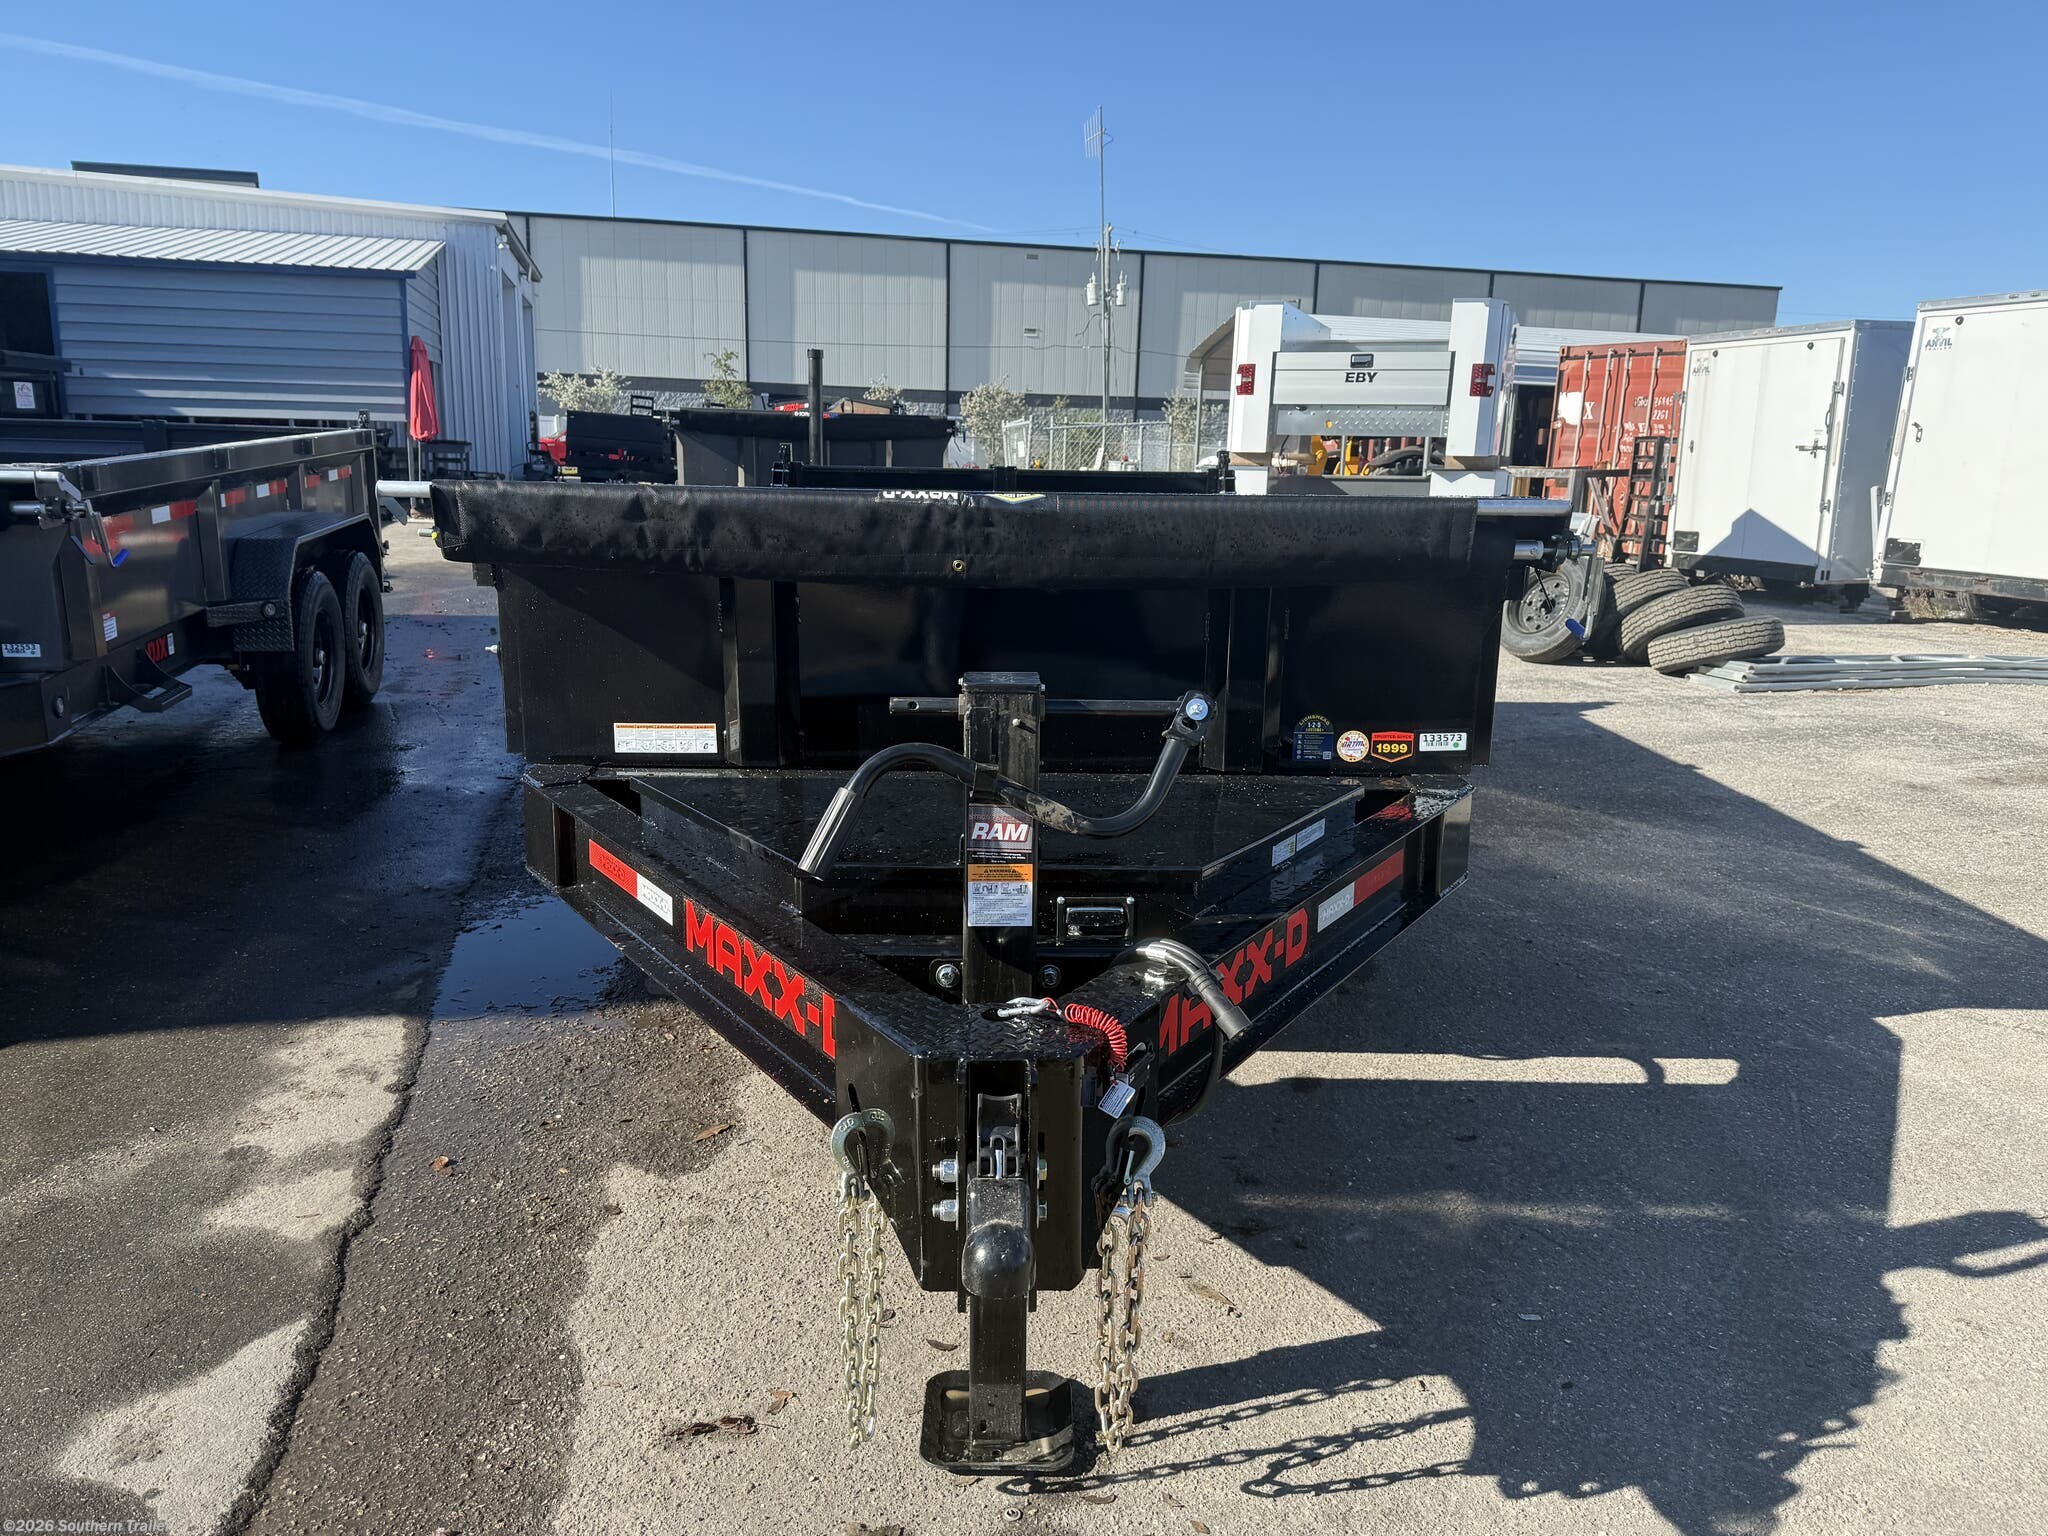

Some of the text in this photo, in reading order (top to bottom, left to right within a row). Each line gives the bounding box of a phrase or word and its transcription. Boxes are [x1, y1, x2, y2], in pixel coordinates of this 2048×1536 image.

[1345, 372, 1378, 383] EBY
[1423, 734, 1463, 742] 133573
[1376, 743, 1408, 753] 1999
[971, 822, 1029, 841] RAM
